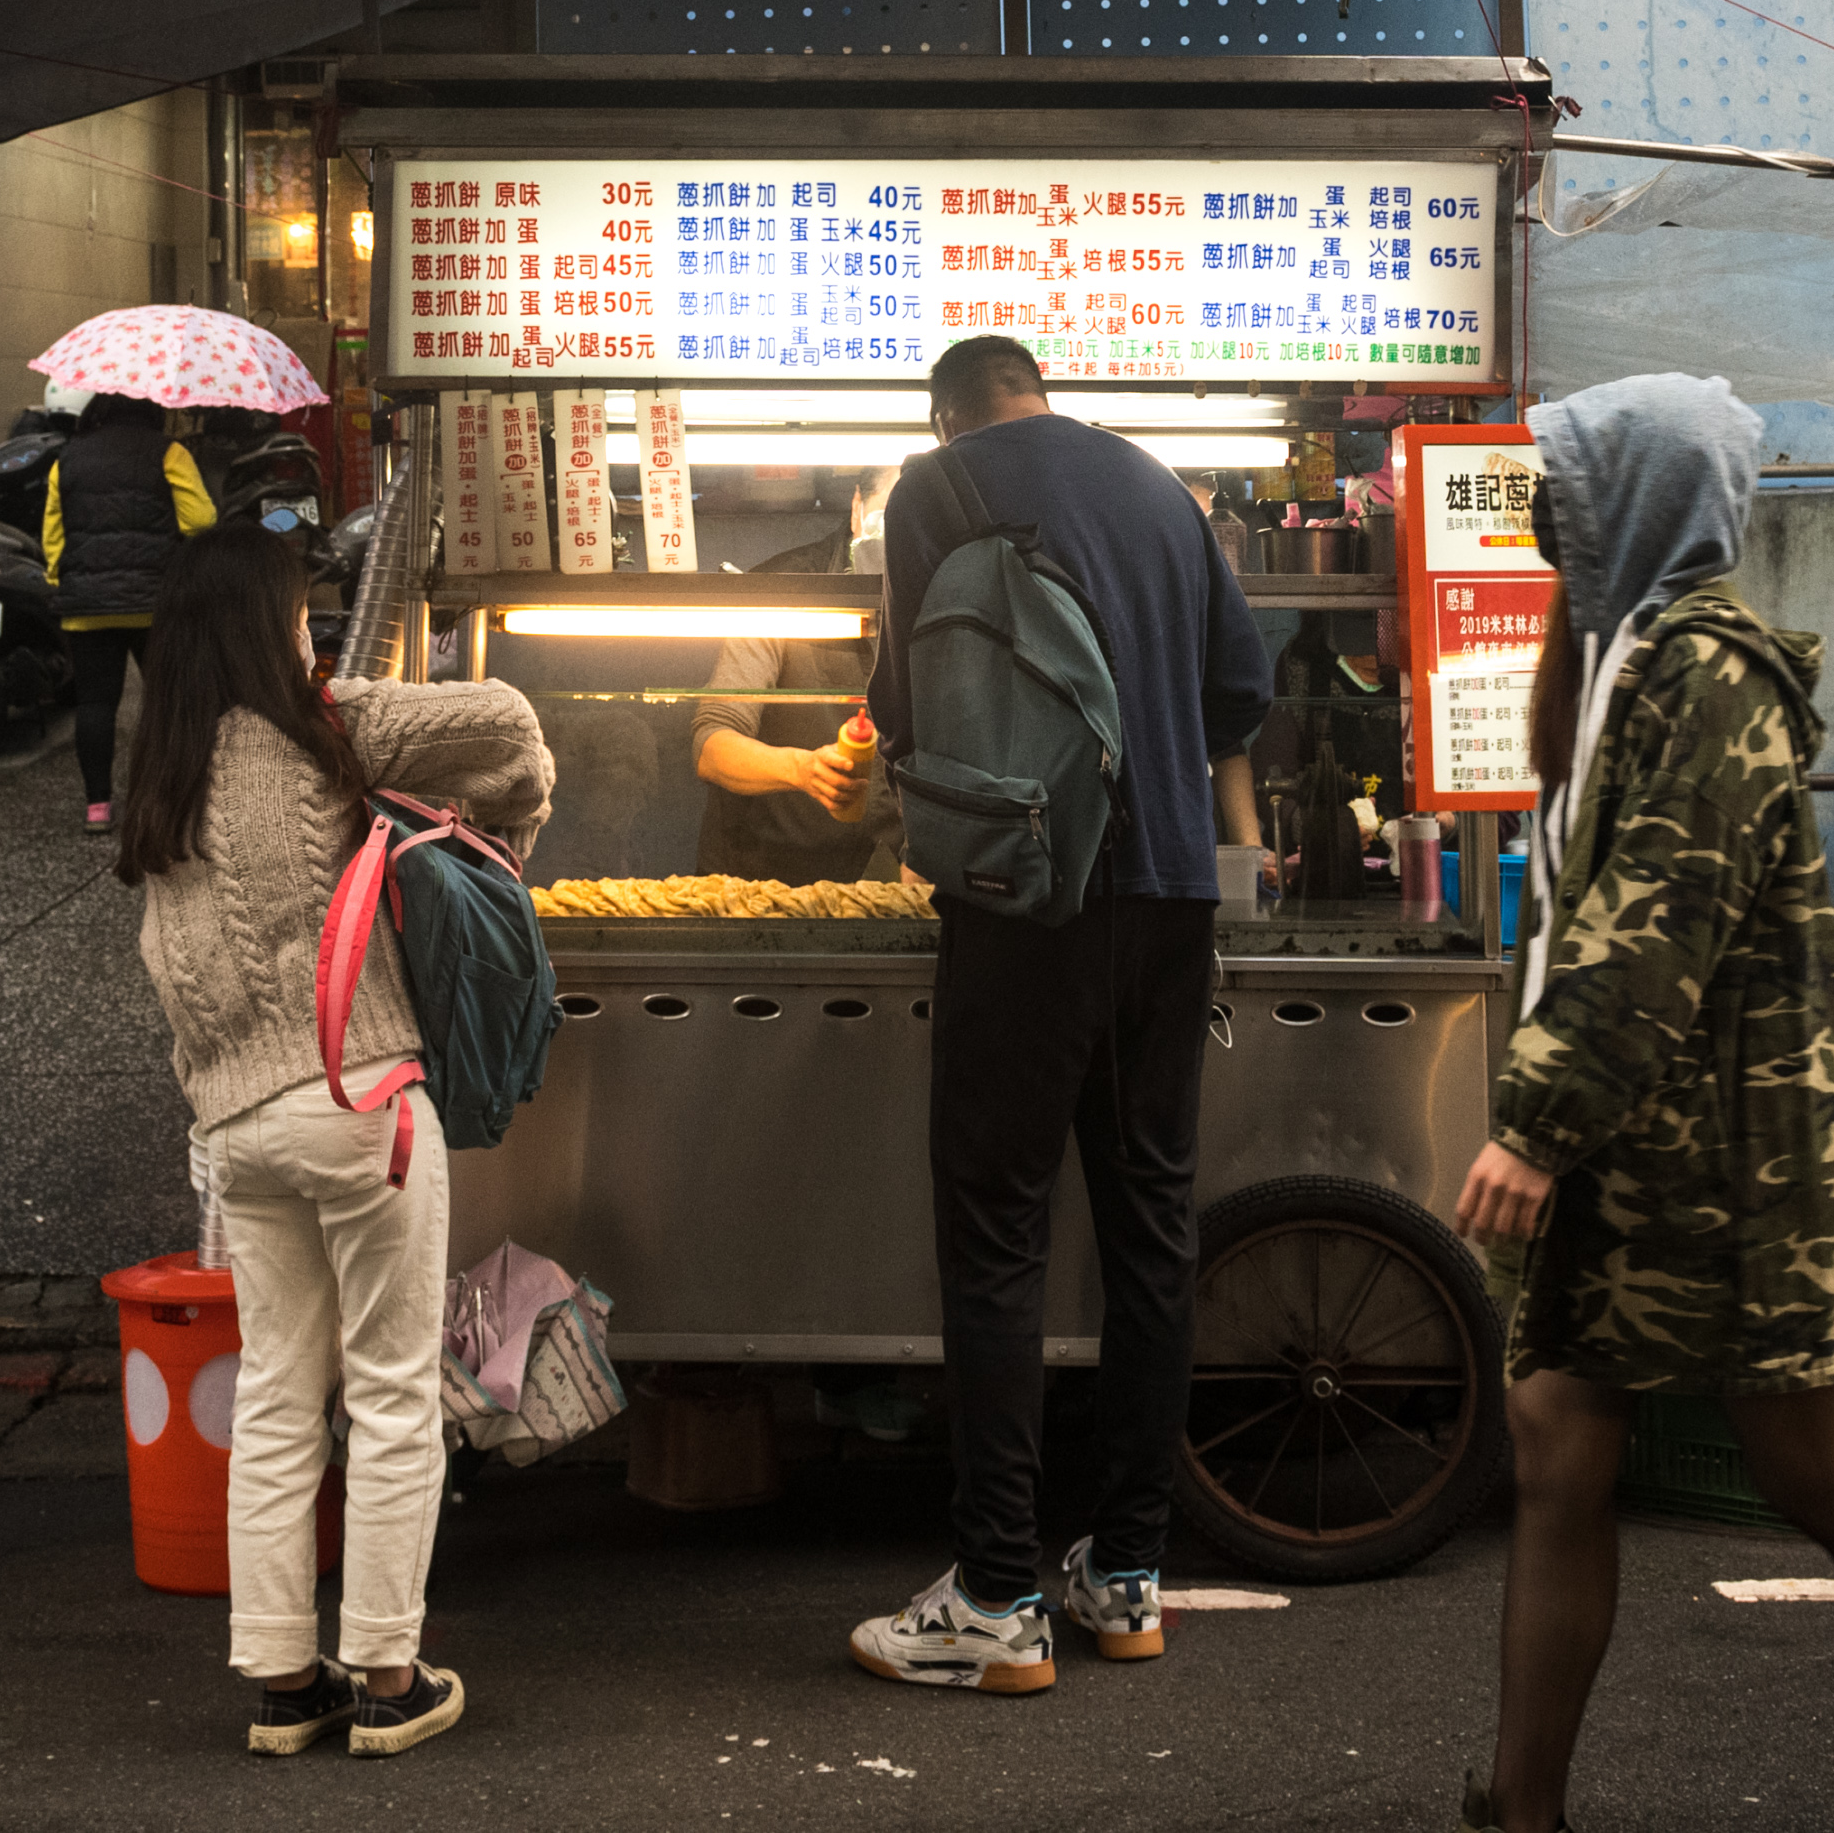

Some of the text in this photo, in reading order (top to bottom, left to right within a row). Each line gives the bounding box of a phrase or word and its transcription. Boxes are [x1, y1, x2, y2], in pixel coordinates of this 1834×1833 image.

[411, 181, 653, 208] 蔥抓餅 原味 30元
[792, 182, 836, 207] 起司
[869, 186, 922, 211] 40元
[1049, 184, 1069, 204] 蛋
[1084, 192, 1126, 216] 火腿
[1132, 193, 1185, 216] 55元
[1325, 186, 1345, 206] 蛋
[1369, 187, 1411, 207] 起司
[1037, 207, 1078, 227] 玉米
[1309, 209, 1350, 228] 玉米
[1428, 197, 1480, 219] 60元
[1369, 210, 1411, 230] 培根
[517, 218, 538, 244] 蛋
[602, 220, 653, 243] 40元
[790, 218, 808, 242] 蛋
[822, 218, 863, 242] 玉米
[869, 220, 921, 244] 45元
[1050, 239, 1068, 258] 蛋
[1323, 237, 1341, 257] 蛋
[1369, 238, 1410, 258] 火腿
[519, 255, 540, 280] 蛋
[554, 255, 597, 279] 起司
[603, 254, 653, 278] 45元
[790, 251, 808, 275] 蛋
[822, 252, 863, 276] 火腿
[869, 255, 921, 278] 50元
[1083, 249, 1126, 272] 培根
[1132, 250, 1184, 271] 55元
[1430, 247, 1480, 269] 65元
[1037, 261, 1078, 280] 玉米
[1309, 259, 1350, 279] 起司
[1369, 260, 1410, 280] 培根
[520, 290, 541, 316] 蛋
[554, 290, 598, 316] 培根
[604, 292, 653, 315] 50元
[790, 293, 808, 316] 蛋
[822, 285, 861, 303] 玉米
[1048, 292, 1066, 311] 蛋
[1086, 293, 1126, 312] 起司
[1306, 293, 1321, 313] 蛋
[1341, 294, 1376, 313] 起司
[821, 307, 861, 325] 起司
[869, 296, 921, 318] 50元
[1132, 304, 1184, 325] 60元
[1037, 314, 1077, 334] 玉米
[1085, 316, 1126, 335] 火腿
[1297, 315, 1331, 334] 玉米
[1341, 316, 1376, 335] 火腿
[1384, 308, 1421, 329] 培根
[1426, 310, 1478, 333] 70元
[523, 326, 541, 346] 蛋
[555, 332, 599, 358] 火腿
[791, 327, 808, 345] 蛋
[512, 347, 554, 368] 起司
[604, 335, 654, 359] 55元
[780, 347, 819, 366] 起司
[823, 338, 864, 359] 培根
[869, 338, 923, 361] 55元
[1369, 343, 1480, 365] 數量可隨意增加
[1446, 473, 1544, 512] 雄記蔥
[1446, 588, 1475, 611] 感謝
